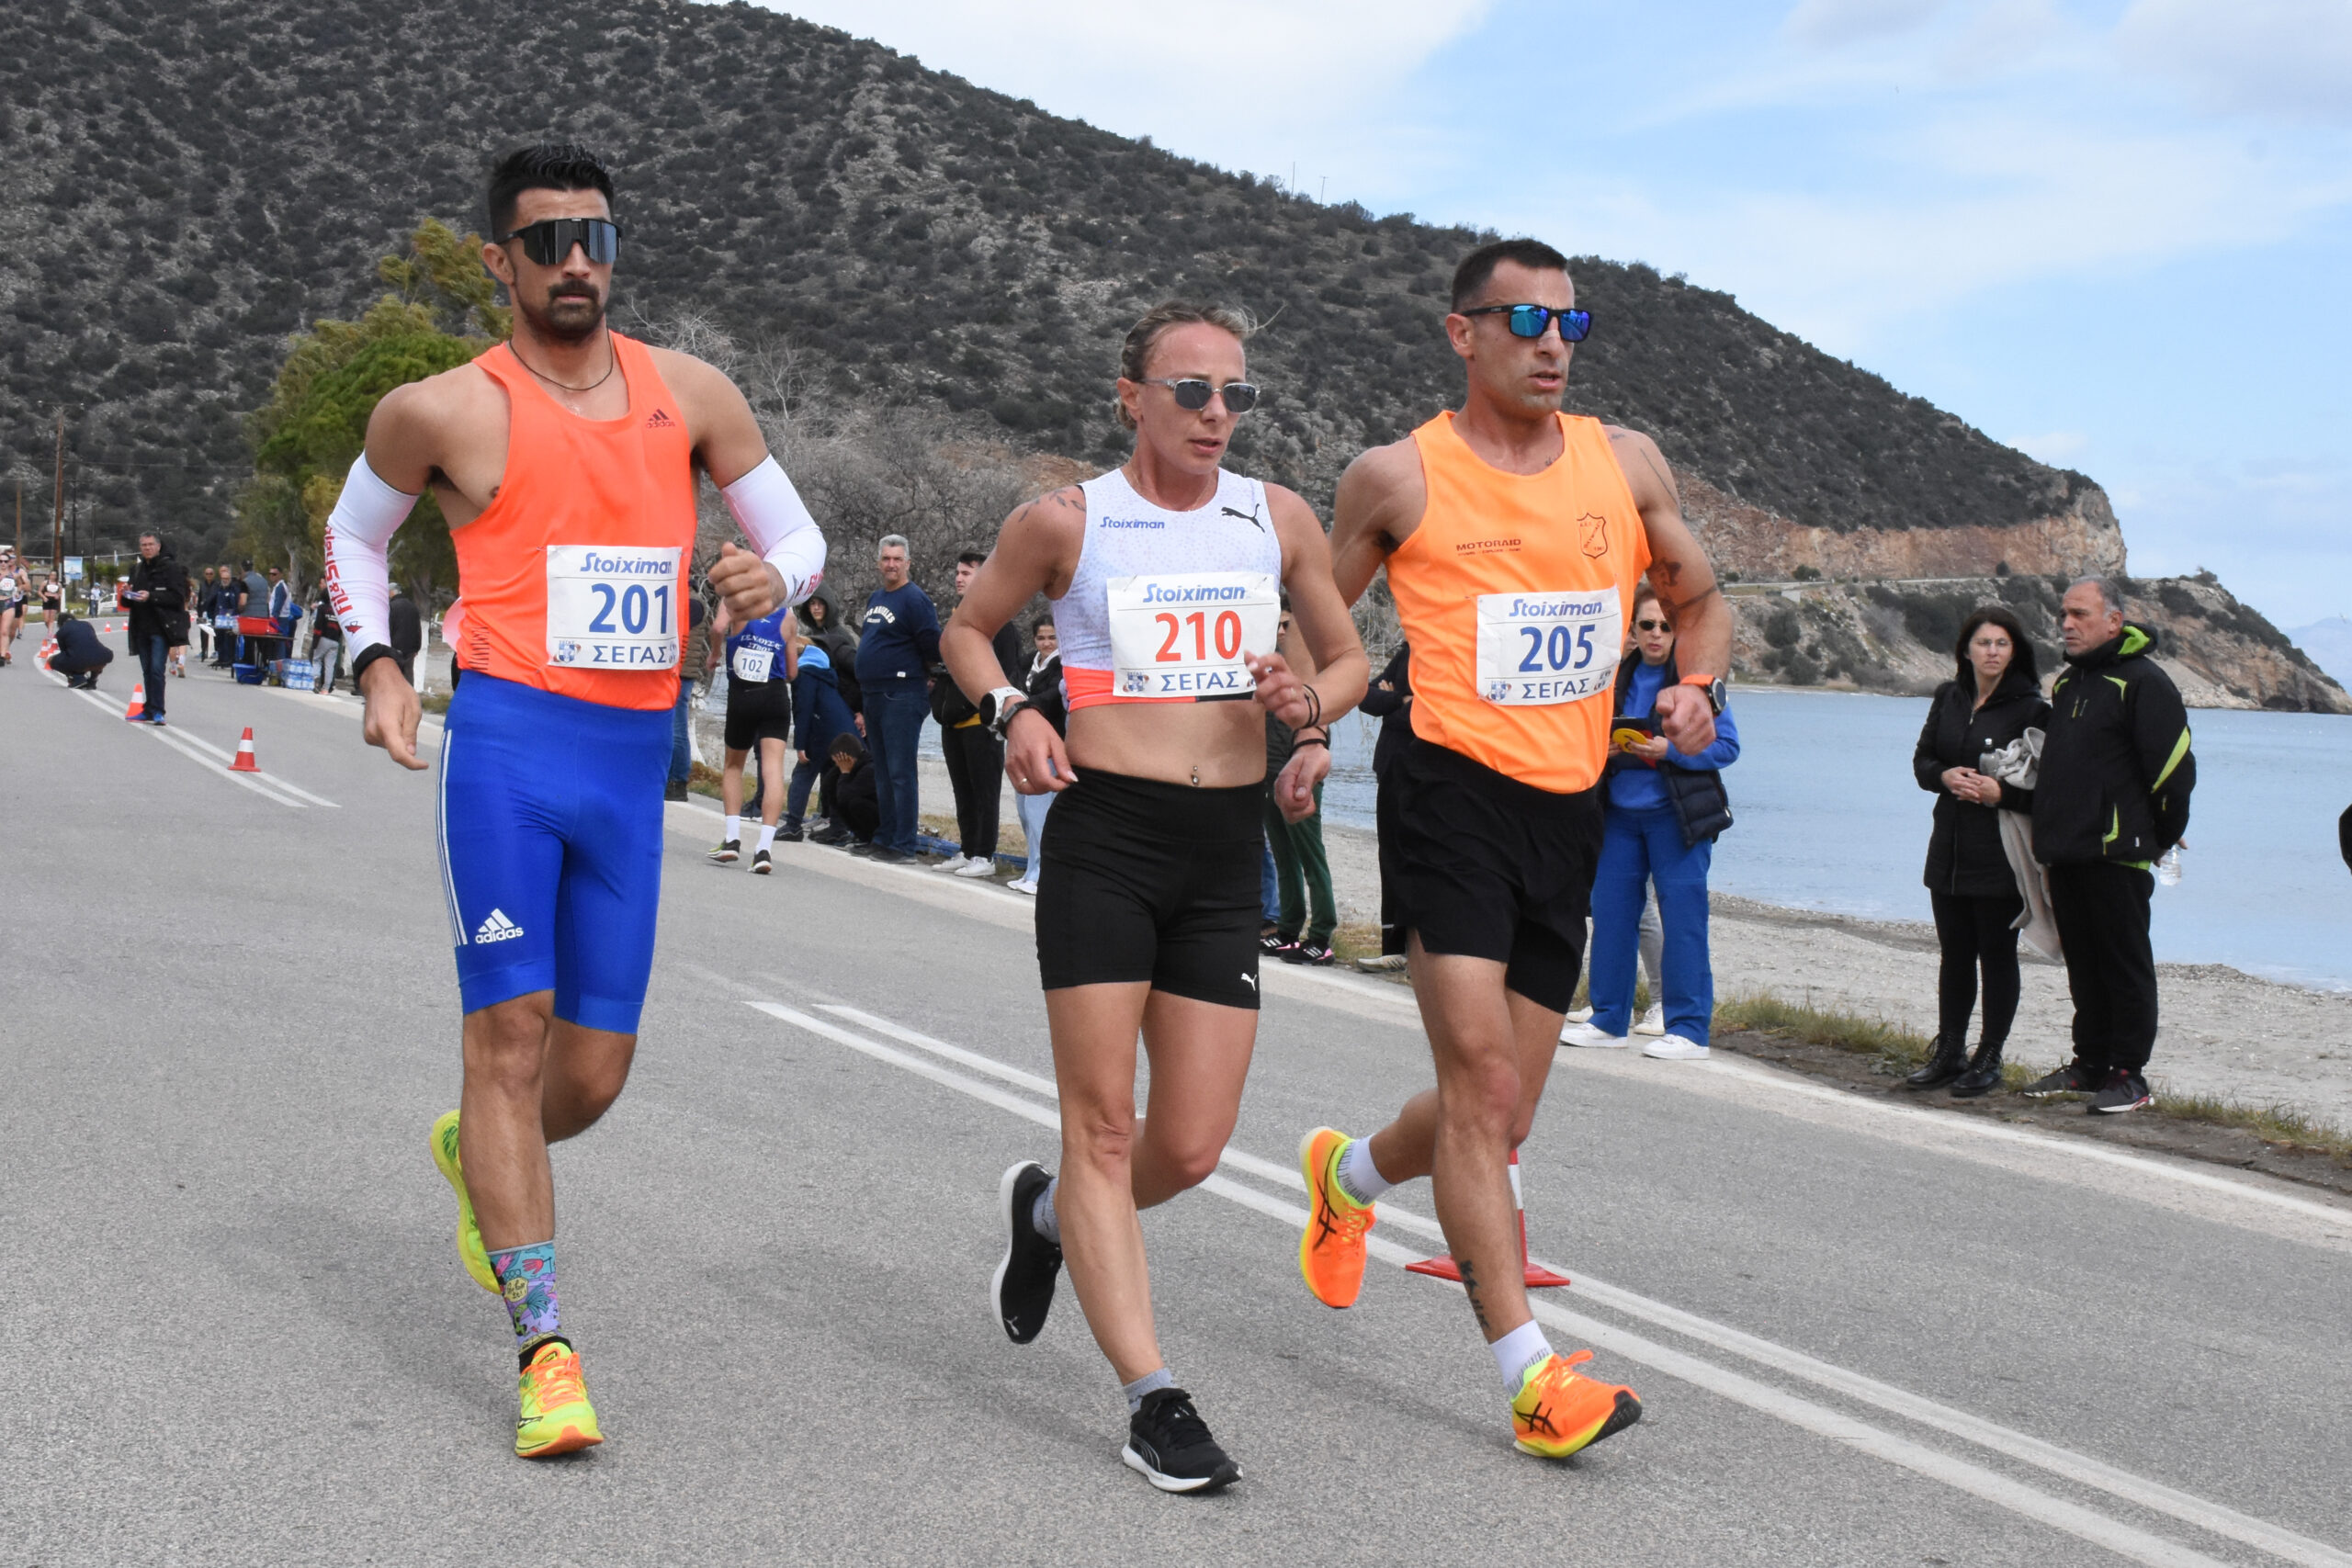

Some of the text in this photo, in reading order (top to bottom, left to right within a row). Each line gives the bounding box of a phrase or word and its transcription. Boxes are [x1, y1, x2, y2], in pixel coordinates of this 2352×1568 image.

[1100, 516, 1165, 529] Stoiximan
[1456, 538, 1521, 551] MOTORAID
[1143, 583, 1246, 603] Stoiximan
[588, 583, 668, 635] 201
[1509, 599, 1602, 617] Stoiximan
[1155, 610, 1242, 662] 210
[593, 645, 667, 663] ΣΕΓΑΣ
[1519, 624, 1596, 672] 205
[742, 658, 763, 672] 102
[1161, 671, 1239, 692] ΣΕΓΑΣ
[1521, 678, 1589, 699] ΣΕΓΑΣ
[475, 927, 524, 944] adidas
